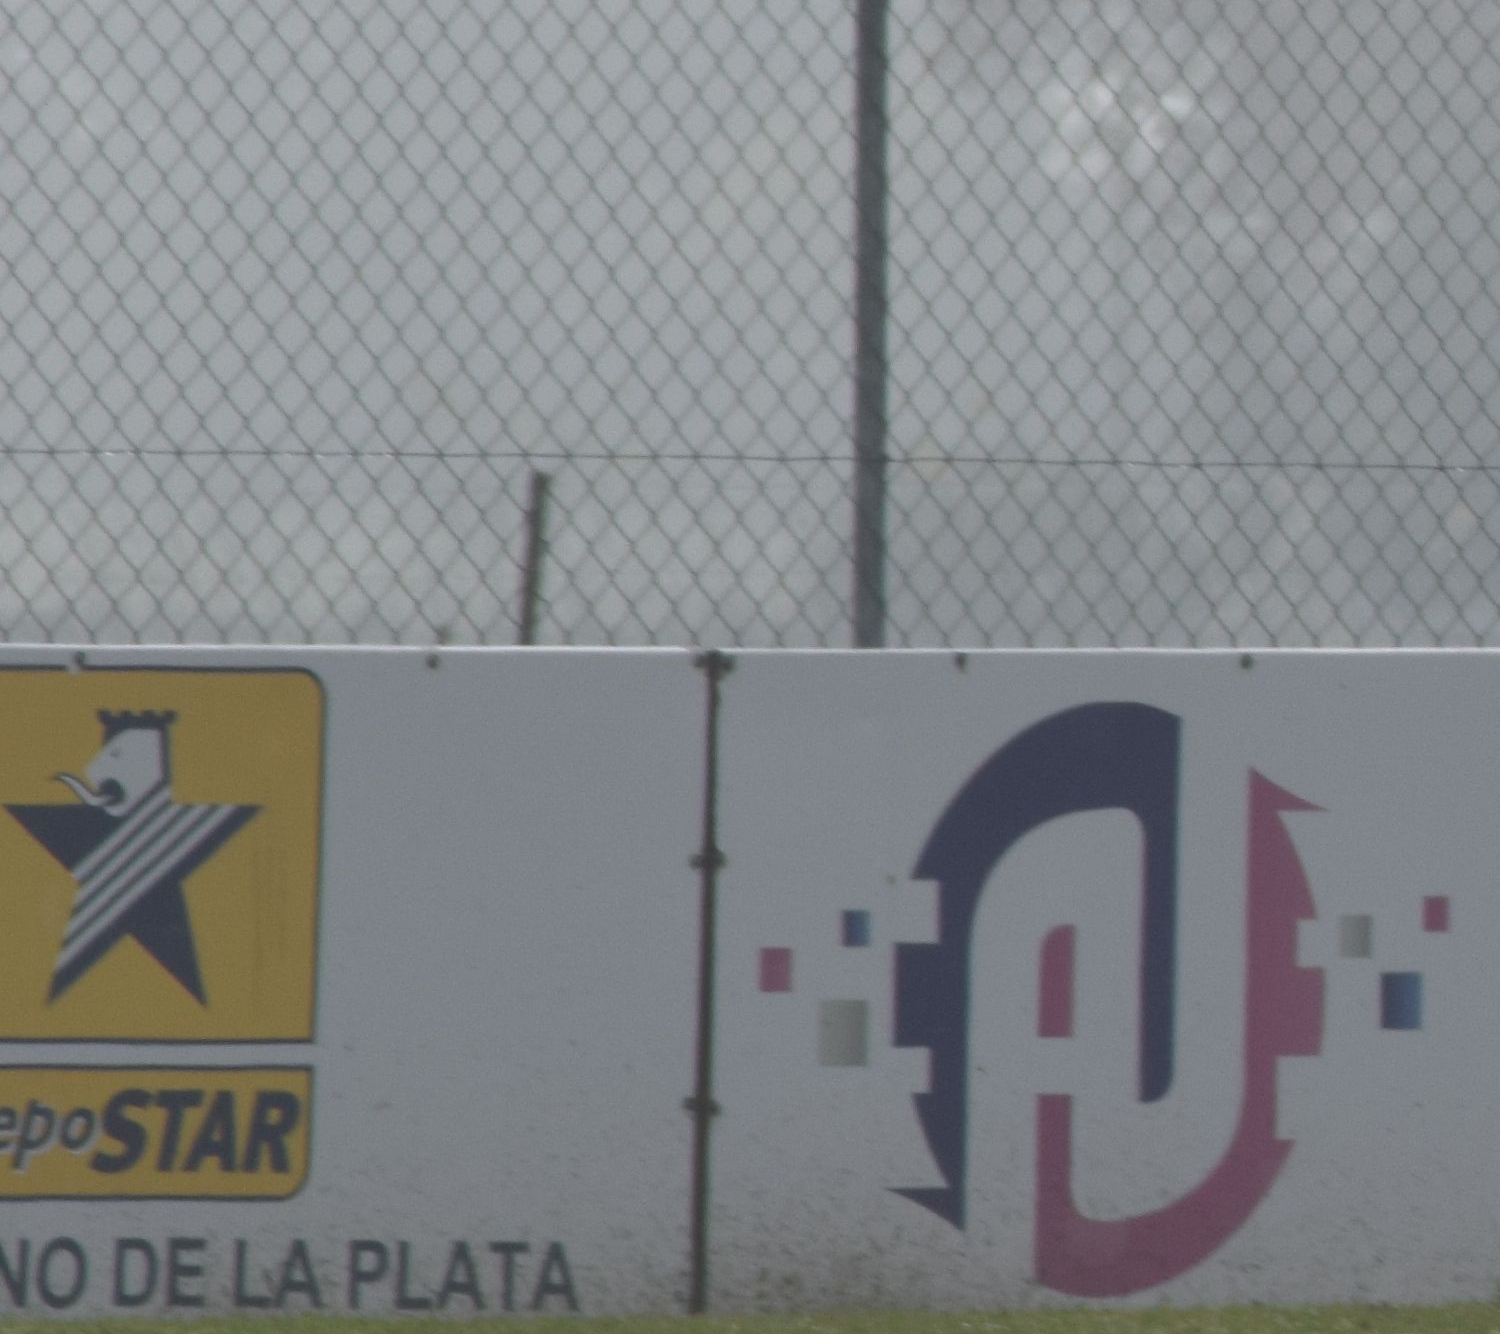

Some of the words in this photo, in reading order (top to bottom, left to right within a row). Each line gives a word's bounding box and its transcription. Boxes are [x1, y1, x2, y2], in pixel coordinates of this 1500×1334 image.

[112, 1237, 209, 1309] DE
[233, 1238, 325, 1310] LA
[346, 1239, 583, 1314] PLATA
